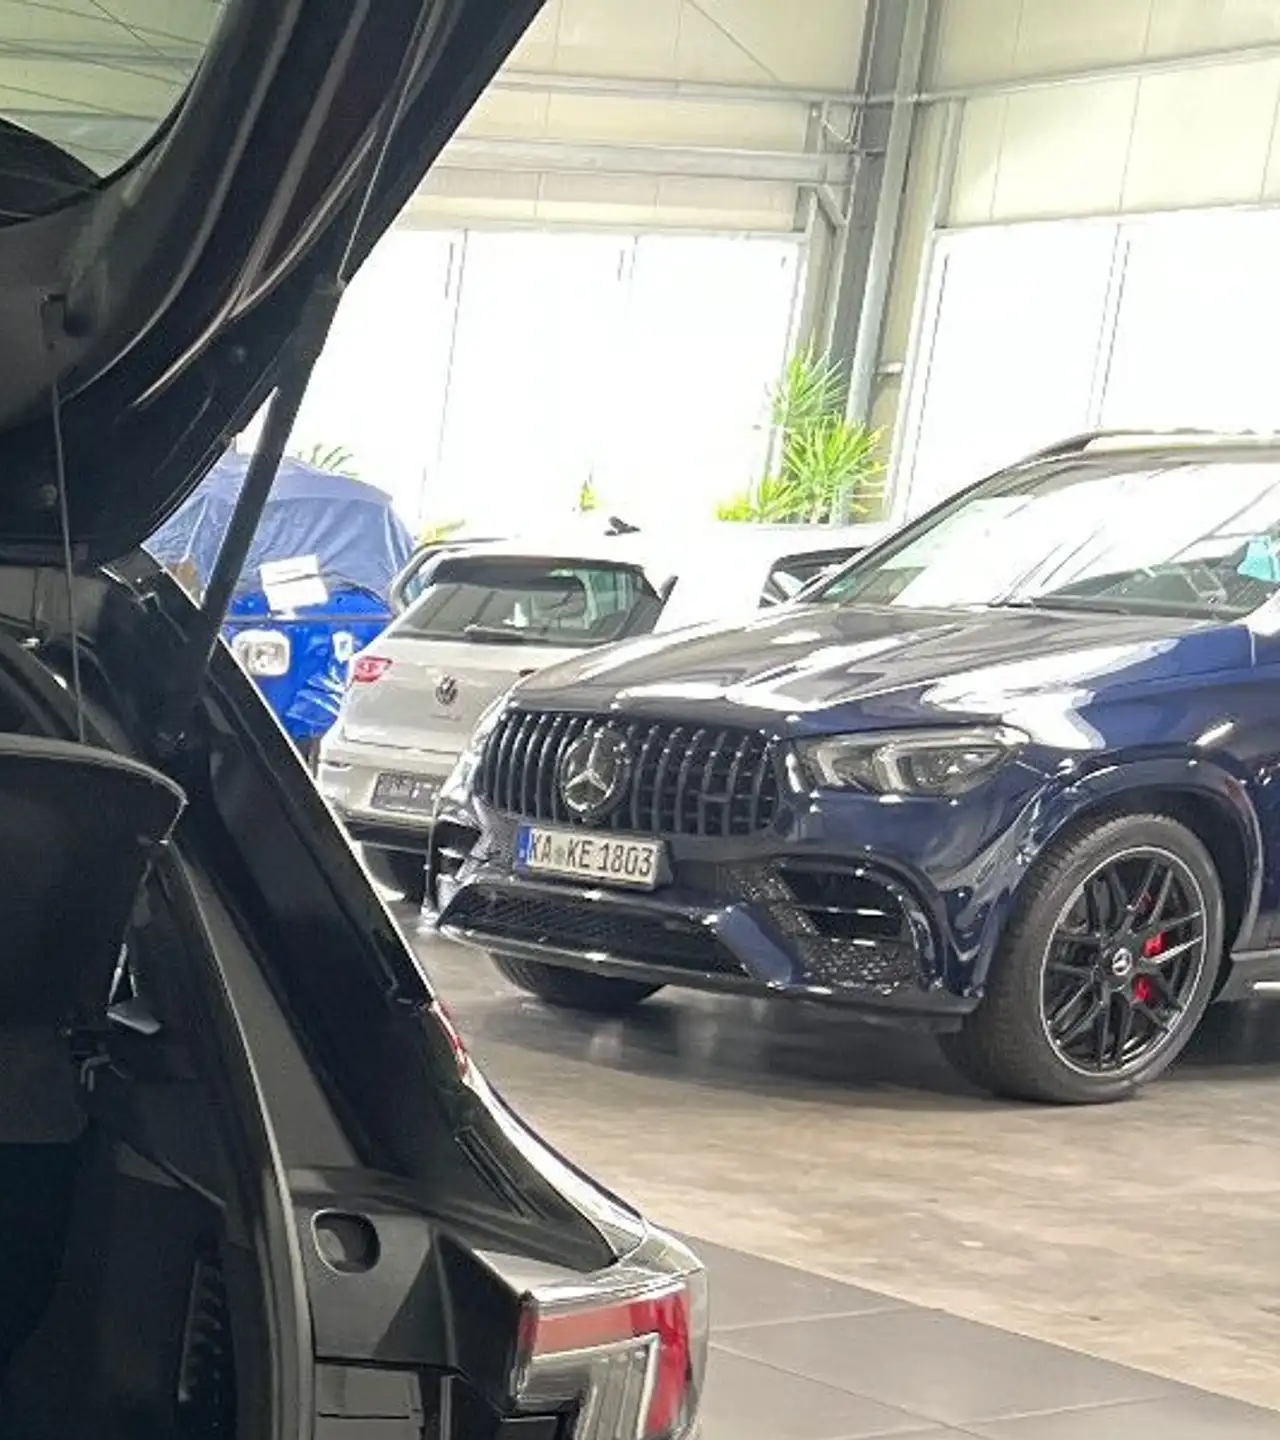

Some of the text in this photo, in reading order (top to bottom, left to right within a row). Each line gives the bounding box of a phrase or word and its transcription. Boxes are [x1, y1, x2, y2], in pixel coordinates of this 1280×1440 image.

[530, 832, 654, 877] KA KE 1803
